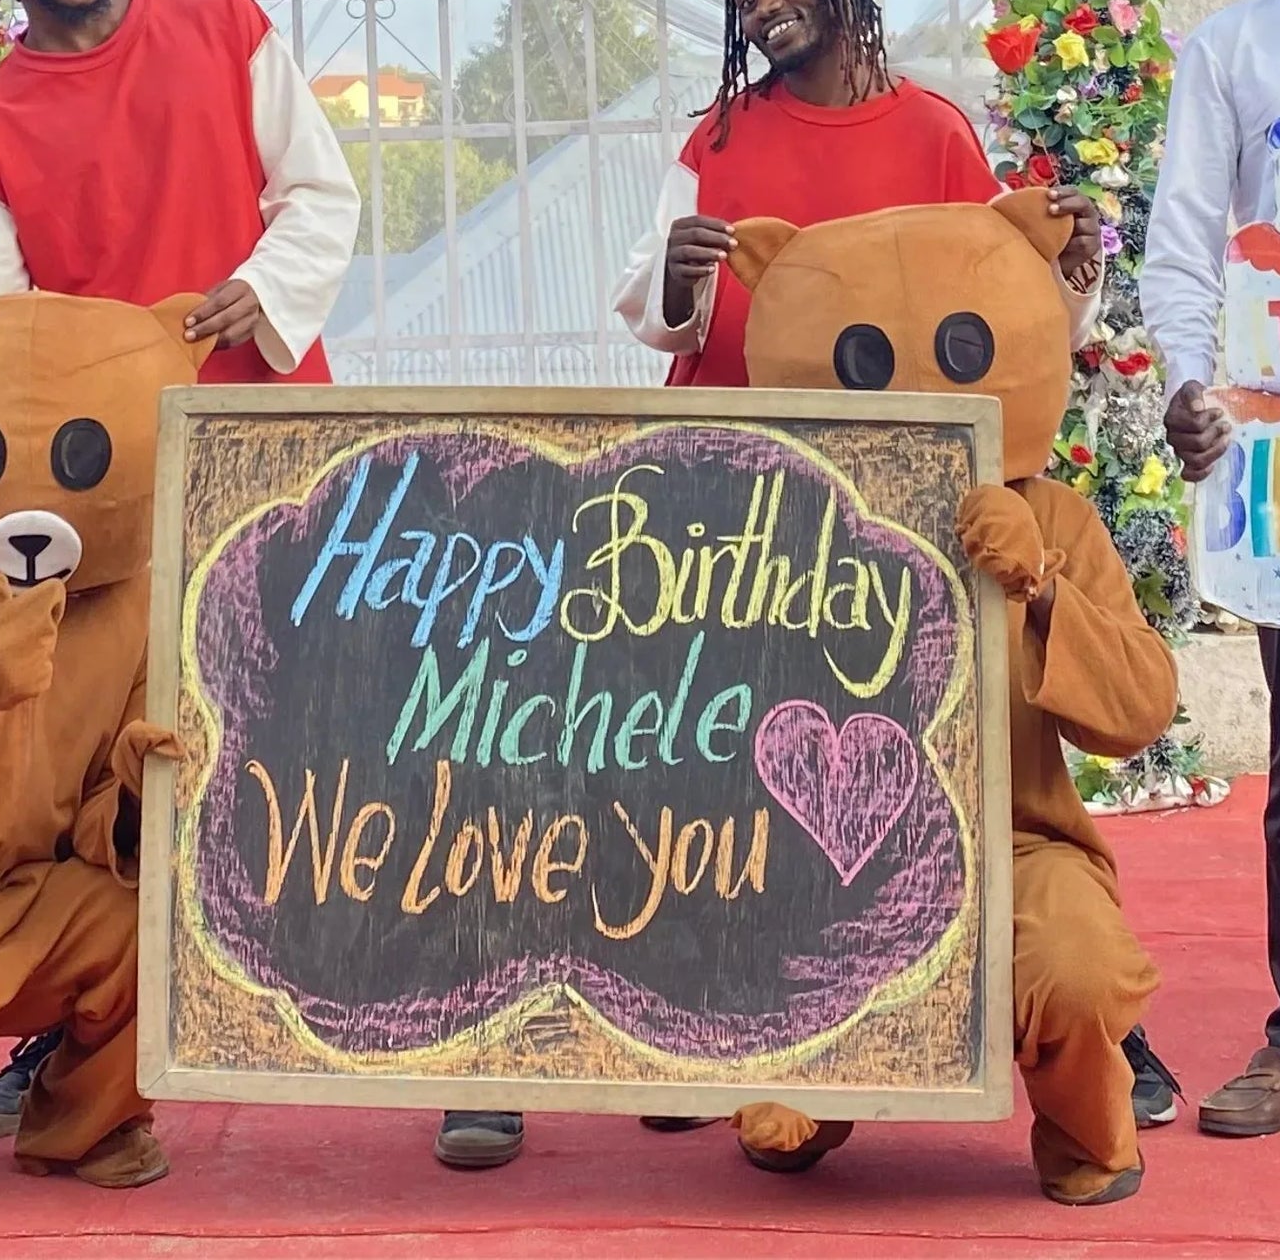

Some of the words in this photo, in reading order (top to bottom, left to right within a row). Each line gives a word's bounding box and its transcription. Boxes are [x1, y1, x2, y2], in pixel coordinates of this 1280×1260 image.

[290, 450, 565, 649] Happy
[559, 464, 912, 699] Birthday
[386, 631, 754, 774] Michele
[244, 757, 396, 907] We
